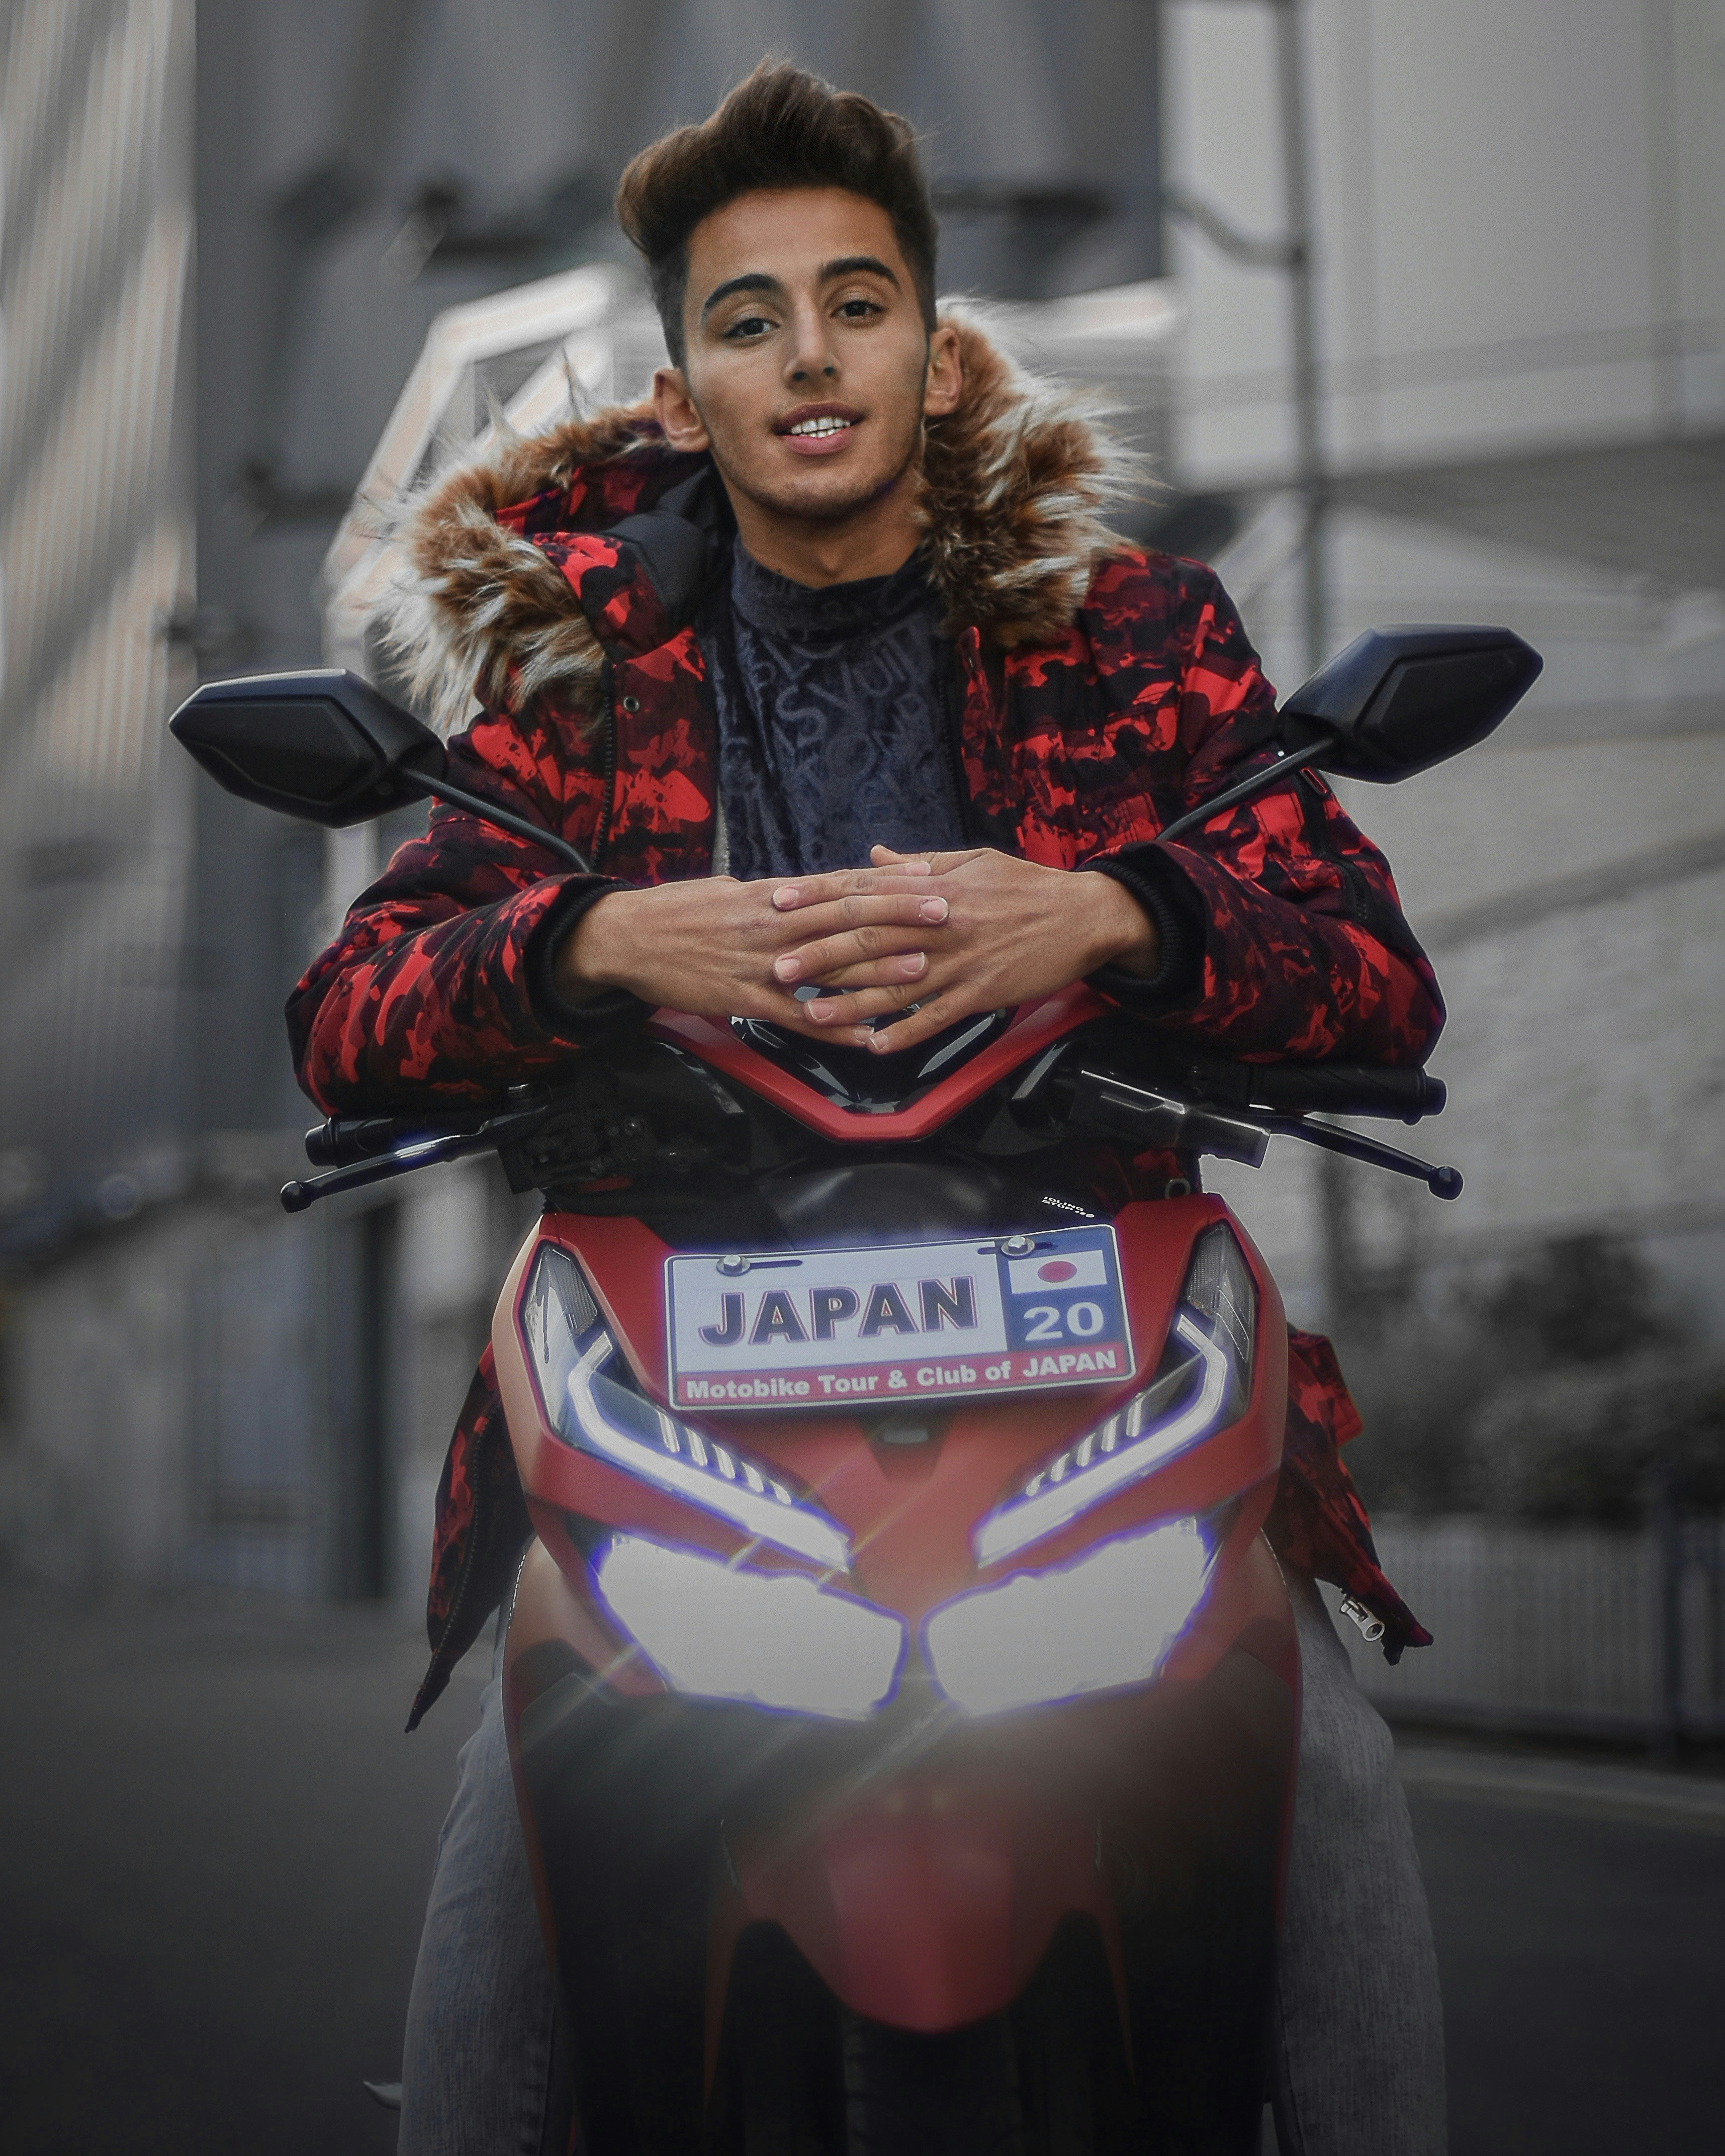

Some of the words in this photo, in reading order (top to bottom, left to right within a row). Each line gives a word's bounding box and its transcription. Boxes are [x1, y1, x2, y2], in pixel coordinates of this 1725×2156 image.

[1044, 1196, 1083, 1211] IDLING
[698, 1276, 977, 1346] JAPAN
[1024, 1301, 1105, 1341] 20
[686, 1377, 810, 1399] Motobike
[818, 1374, 879, 1394] Tour
[888, 1369, 907, 1389] &
[916, 1364, 977, 1387] Club
[984, 1360, 1011, 1381] of
[1022, 1349, 1117, 1377] JAPAN
